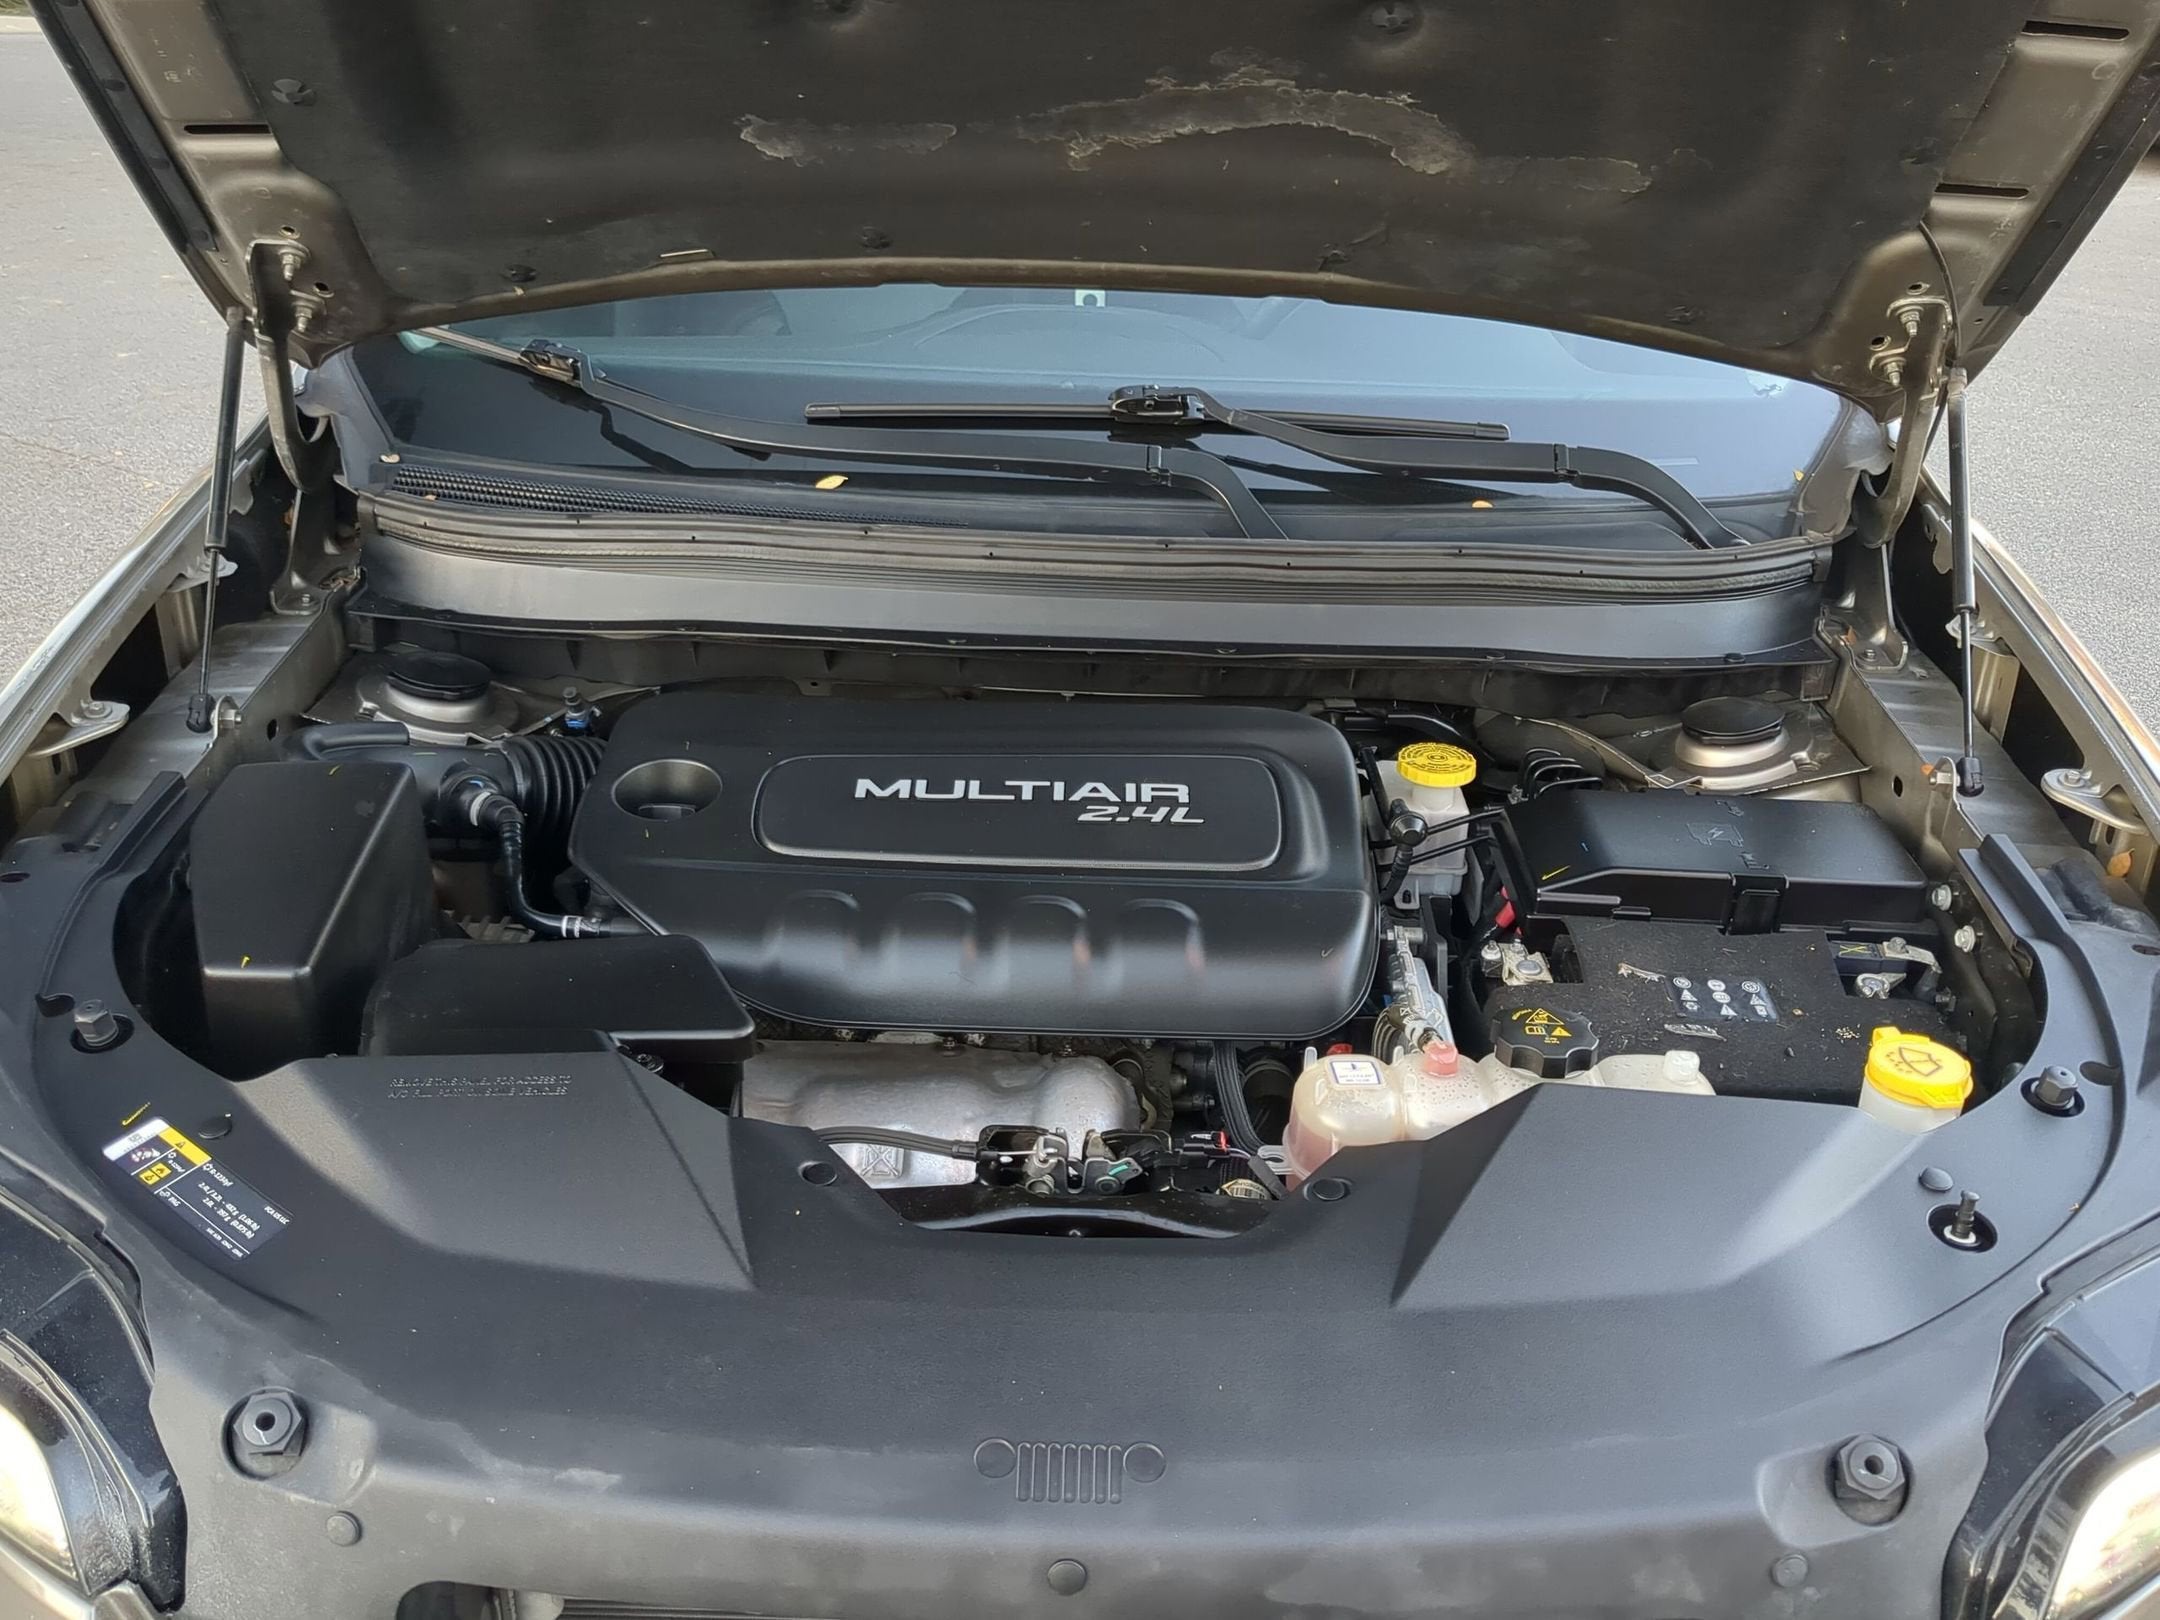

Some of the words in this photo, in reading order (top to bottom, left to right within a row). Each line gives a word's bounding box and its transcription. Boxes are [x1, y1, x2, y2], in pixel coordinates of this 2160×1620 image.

[855, 778, 1191, 804] MULTIAIR
[1077, 805, 1205, 824] 2.4L
[493, 1076, 515, 1085] FOR
[516, 1075, 557, 1084] ACCESS
[559, 1075, 572, 1084] TO
